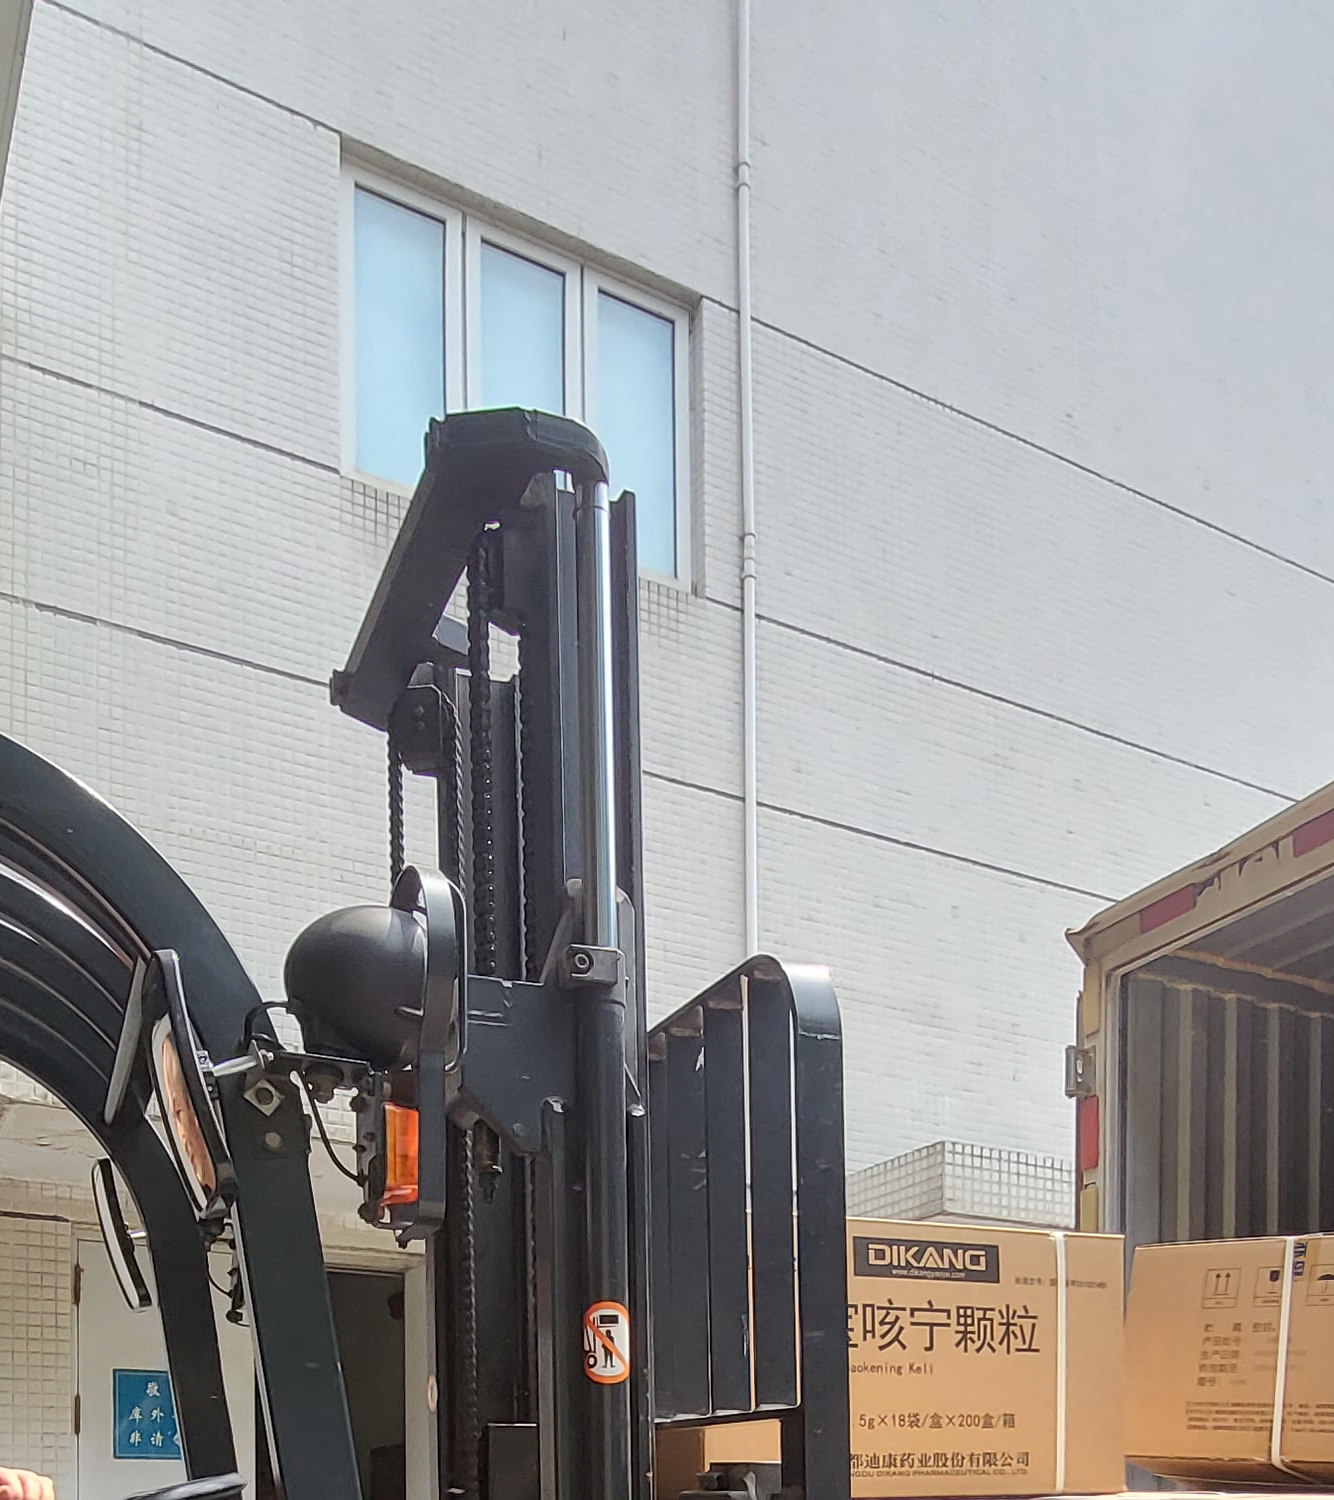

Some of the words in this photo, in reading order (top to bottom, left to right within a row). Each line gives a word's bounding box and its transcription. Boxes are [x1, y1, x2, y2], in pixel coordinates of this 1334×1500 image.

[867, 1243, 987, 1271] DIKANG
[847, 1298, 1042, 1355] 咳宁颗粒
[849, 1362, 904, 1375] aokening
[909, 1362, 934, 1376] Keli
[129, 1406, 176, 1426] 库外
[852, 1412, 1016, 1430] .5g×18袋/盒×200盒/箱
[850, 1451, 1030, 1469] 都迪康药业股份有限公司
